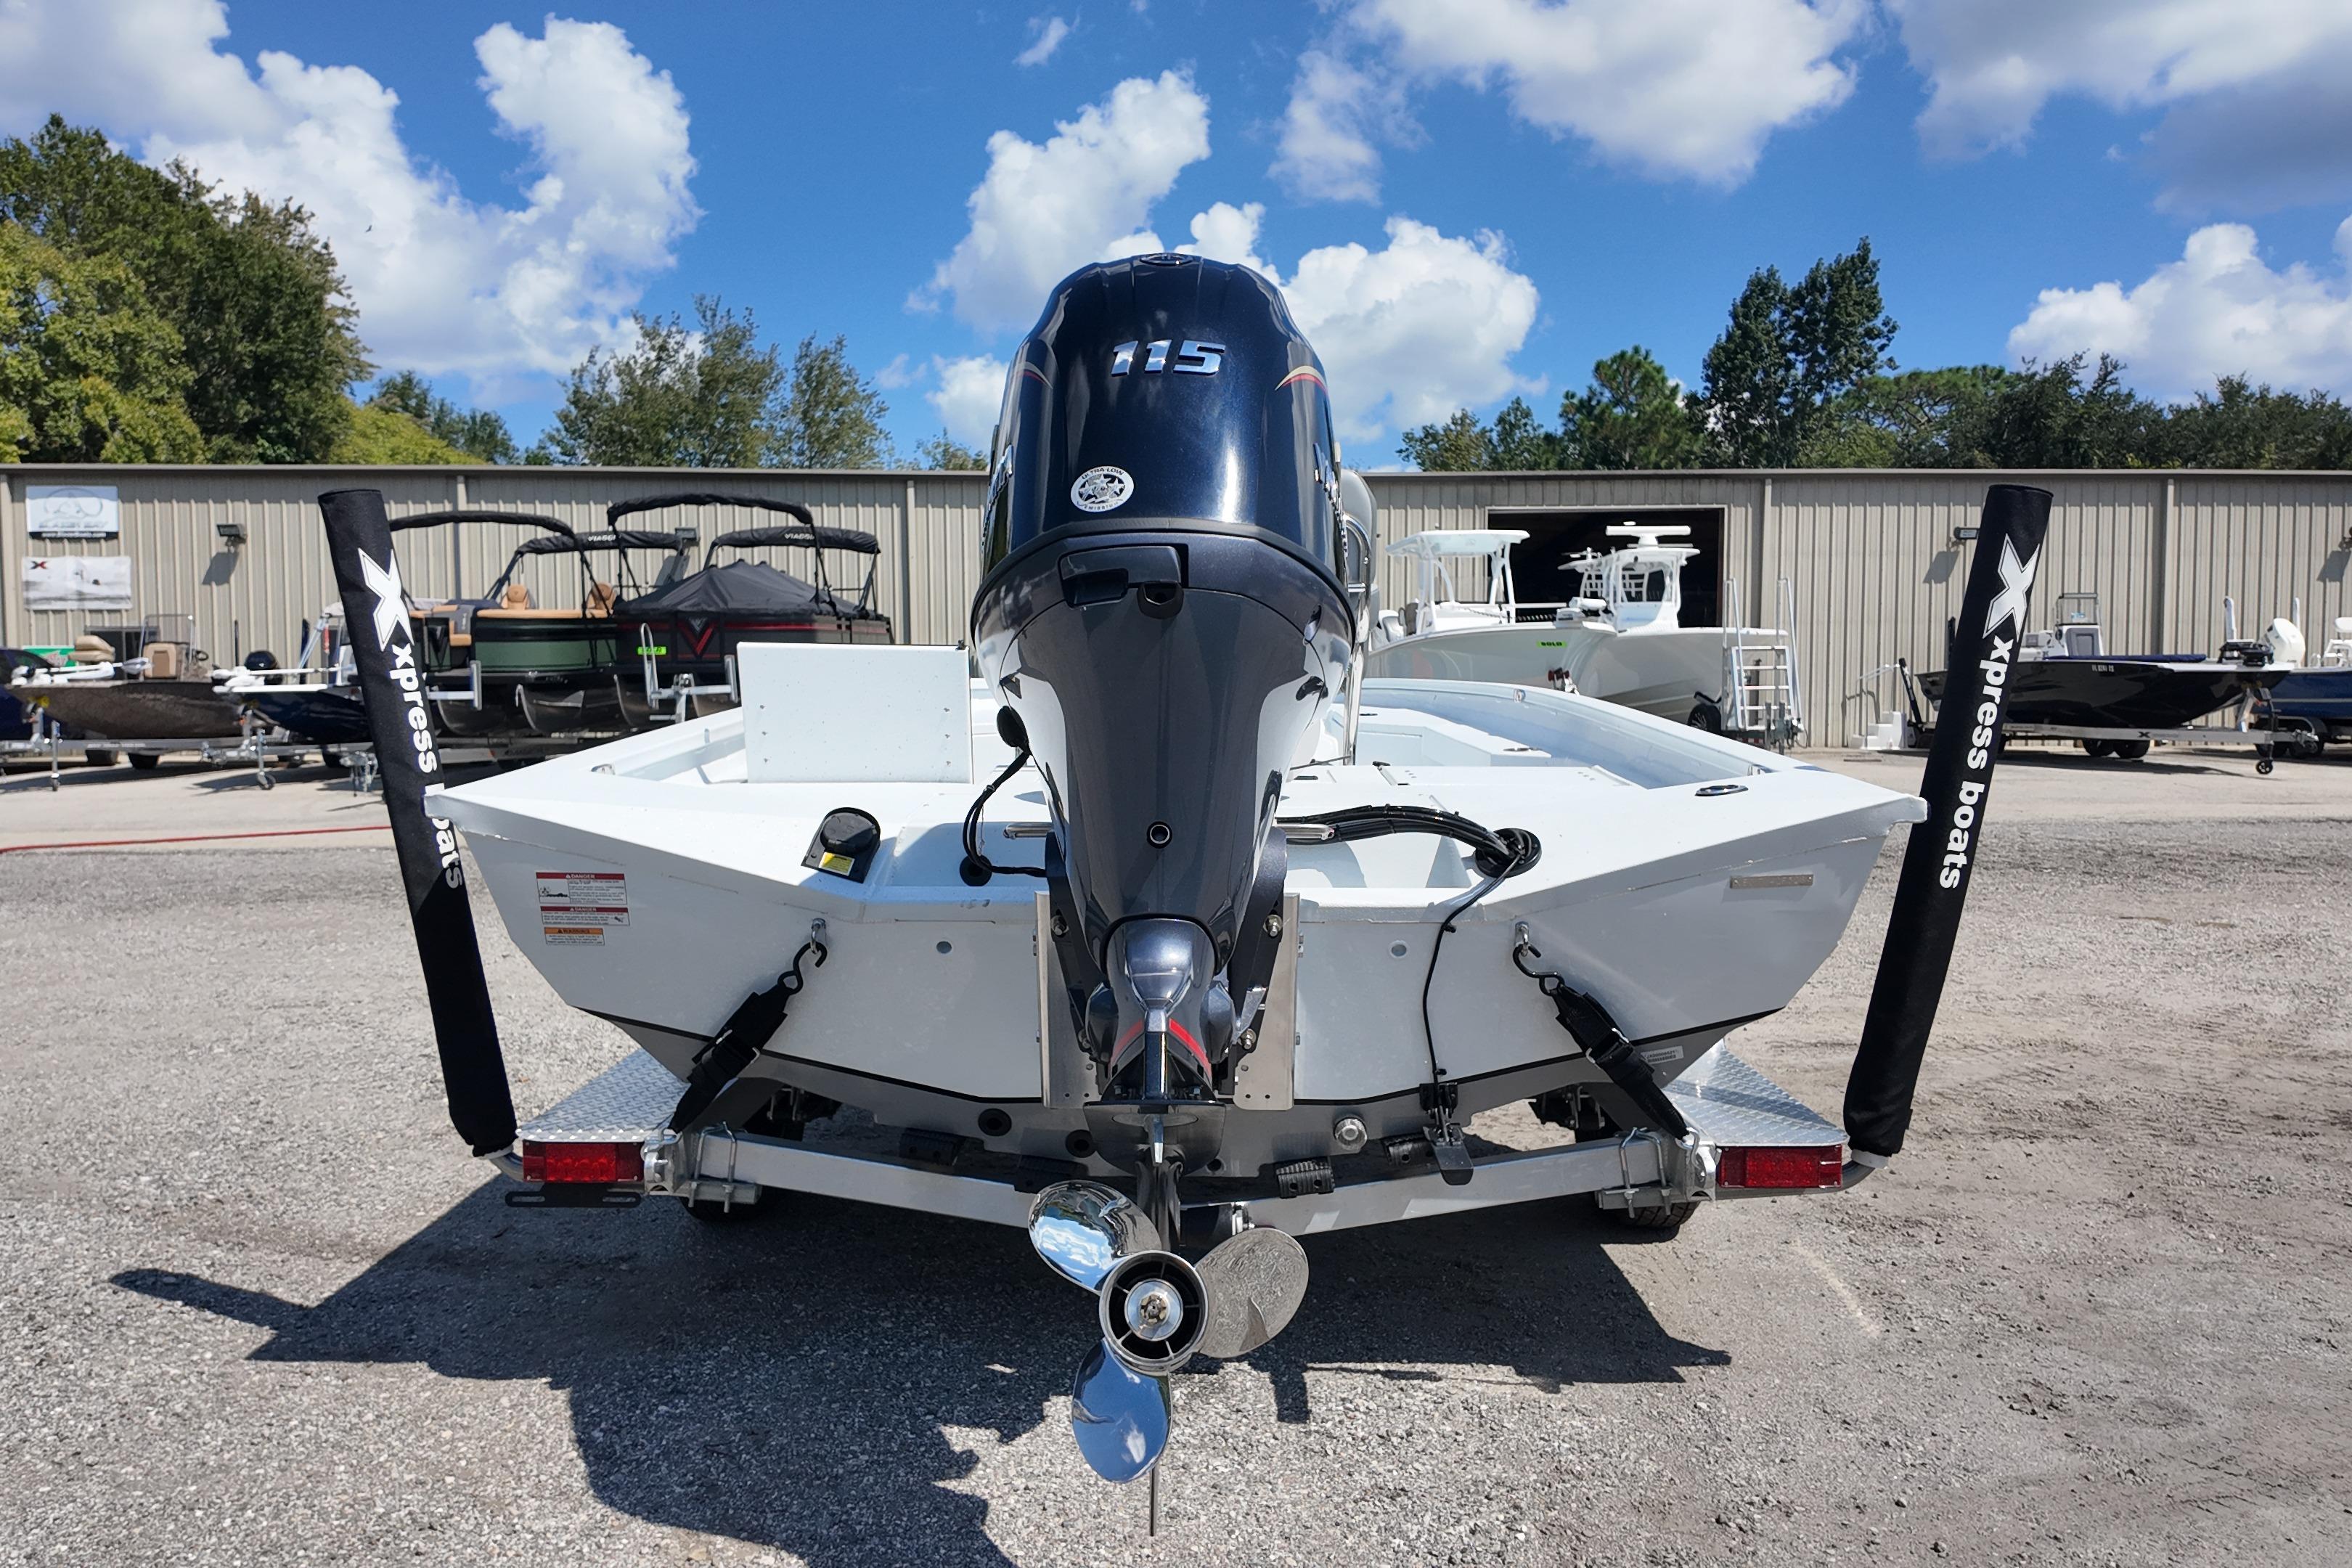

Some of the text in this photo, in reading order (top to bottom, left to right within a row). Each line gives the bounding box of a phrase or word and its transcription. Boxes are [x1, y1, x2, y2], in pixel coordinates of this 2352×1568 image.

[1111, 339, 1226, 377] 115
[1081, 467, 1105, 480] ULTRA
[390, 643, 438, 774] xpress
[1967, 635, 2014, 770] xpress
[1939, 780, 1985, 889] boats
